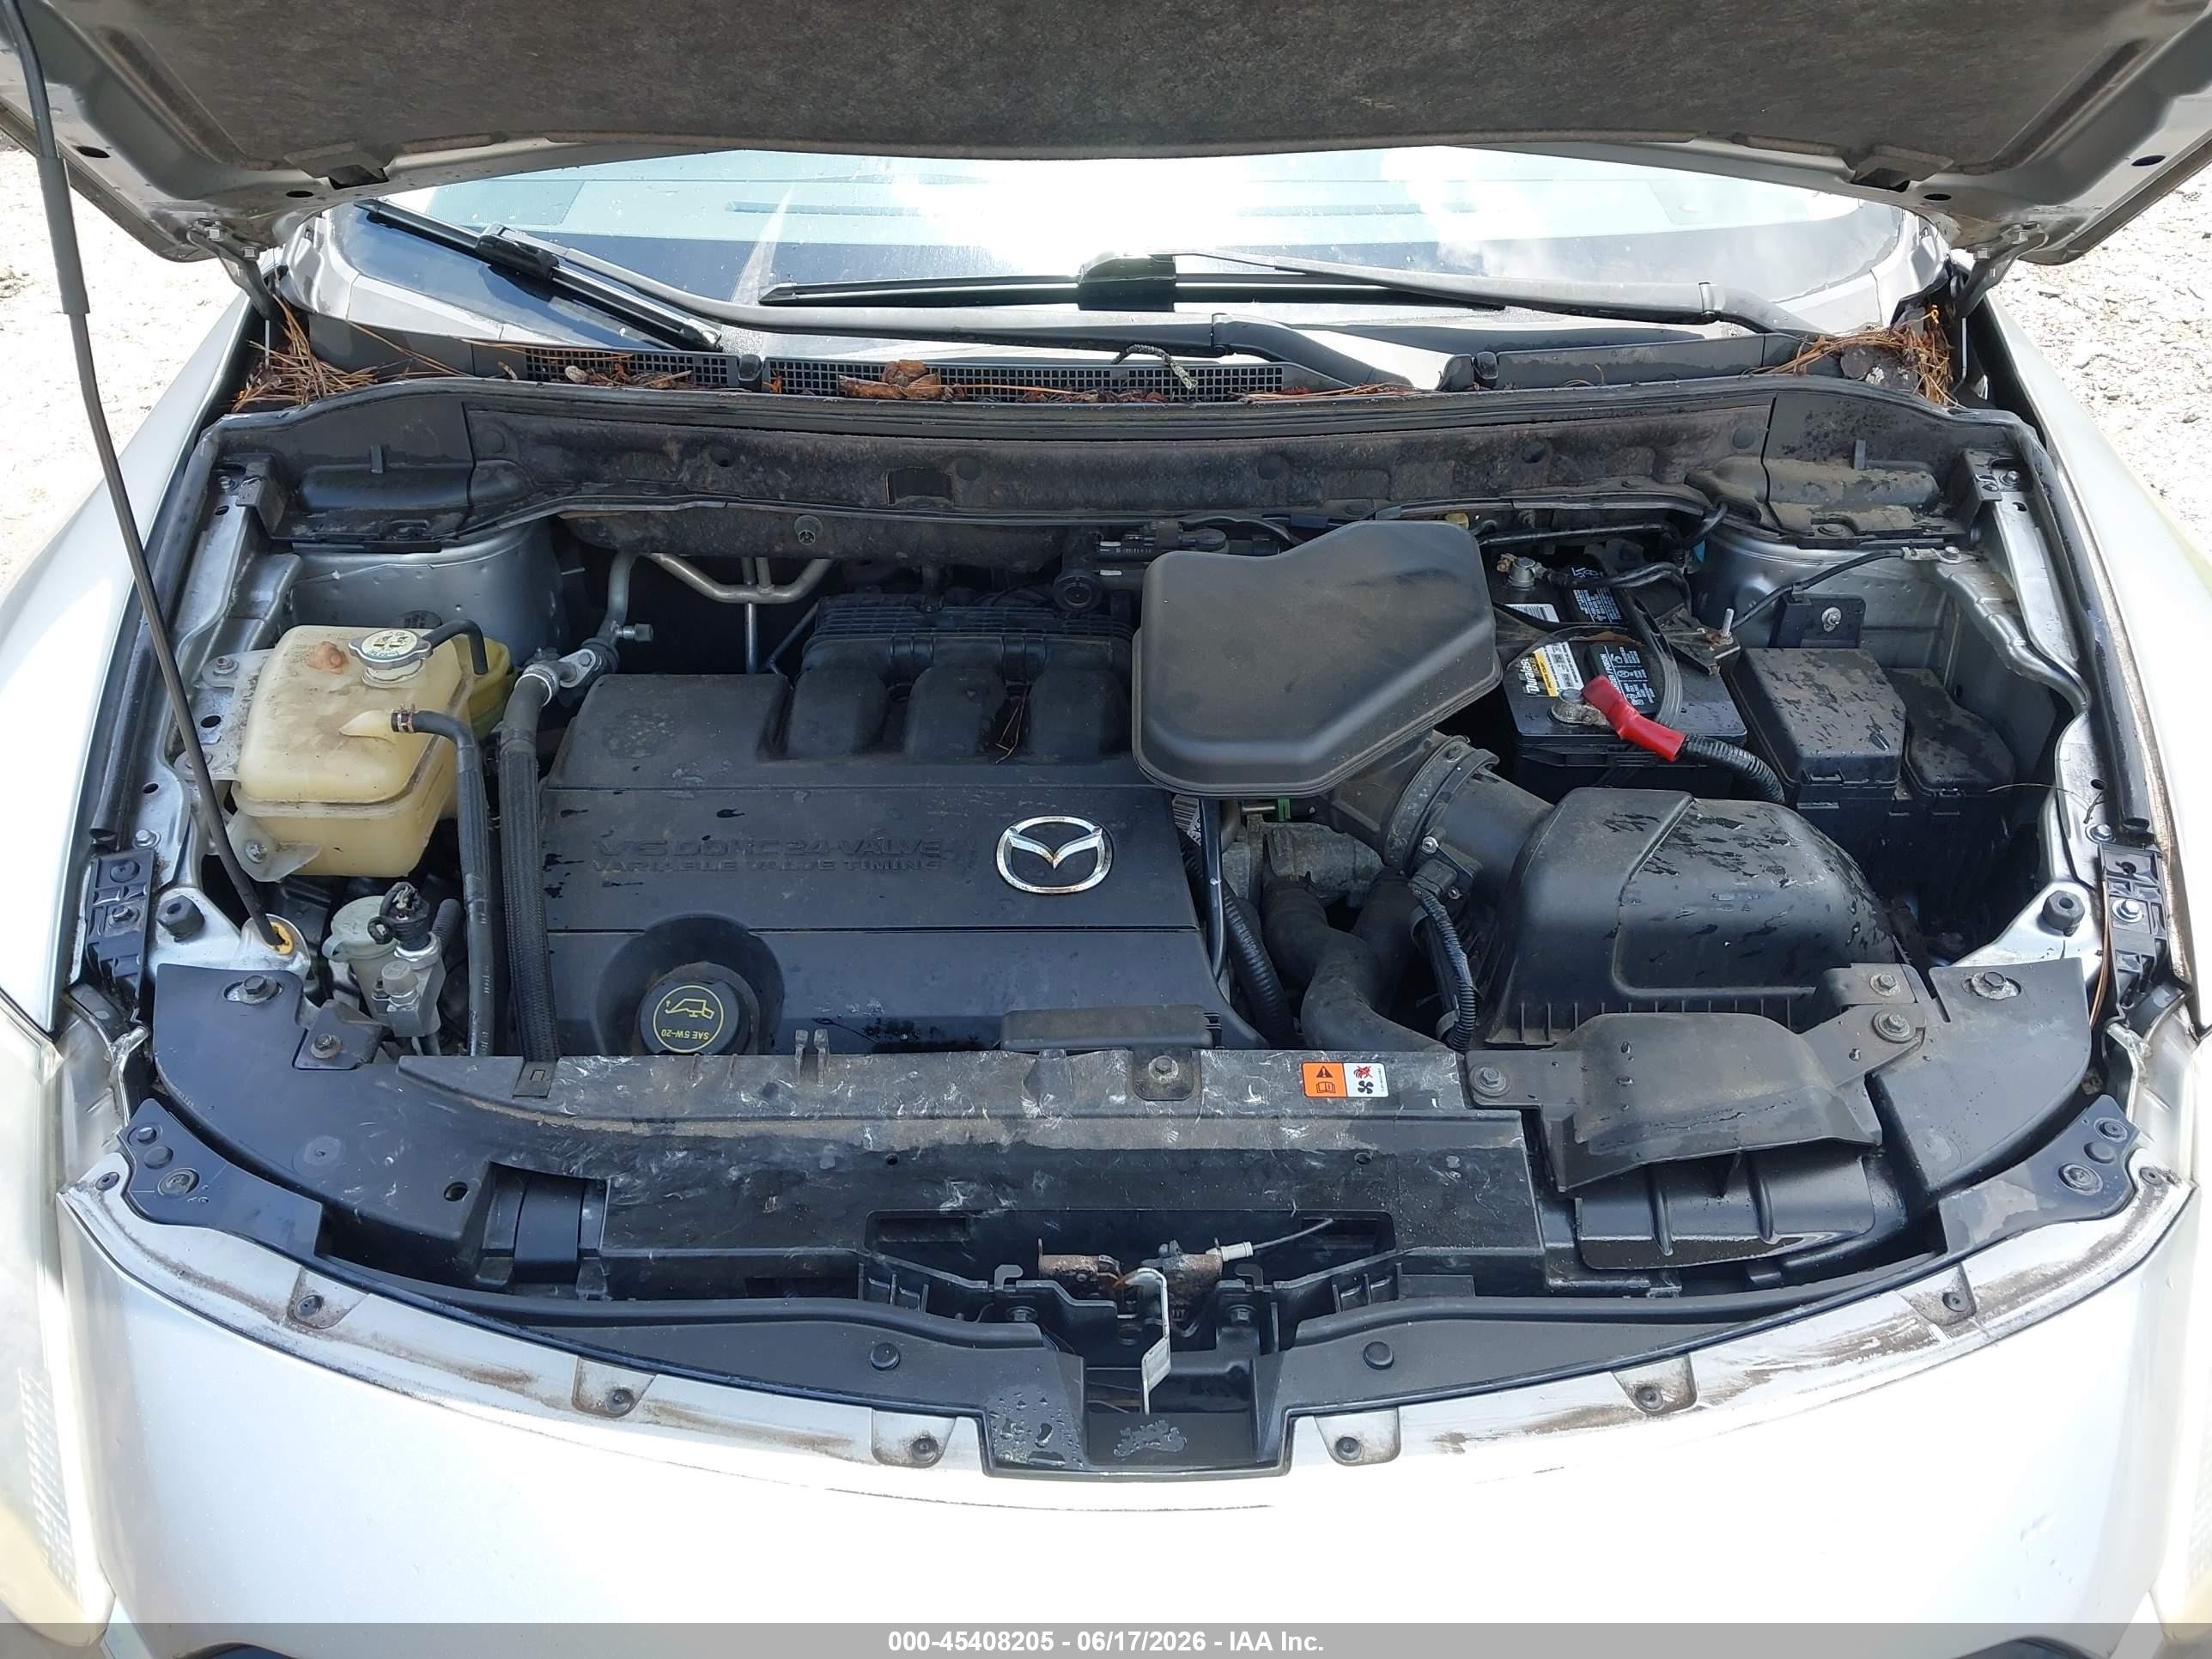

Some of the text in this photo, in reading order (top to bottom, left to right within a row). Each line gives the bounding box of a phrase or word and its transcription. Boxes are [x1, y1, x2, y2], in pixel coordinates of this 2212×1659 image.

[1520, 658, 1540, 693] Duralast
[661, 1029, 710, 1041] SAE 5W-20
